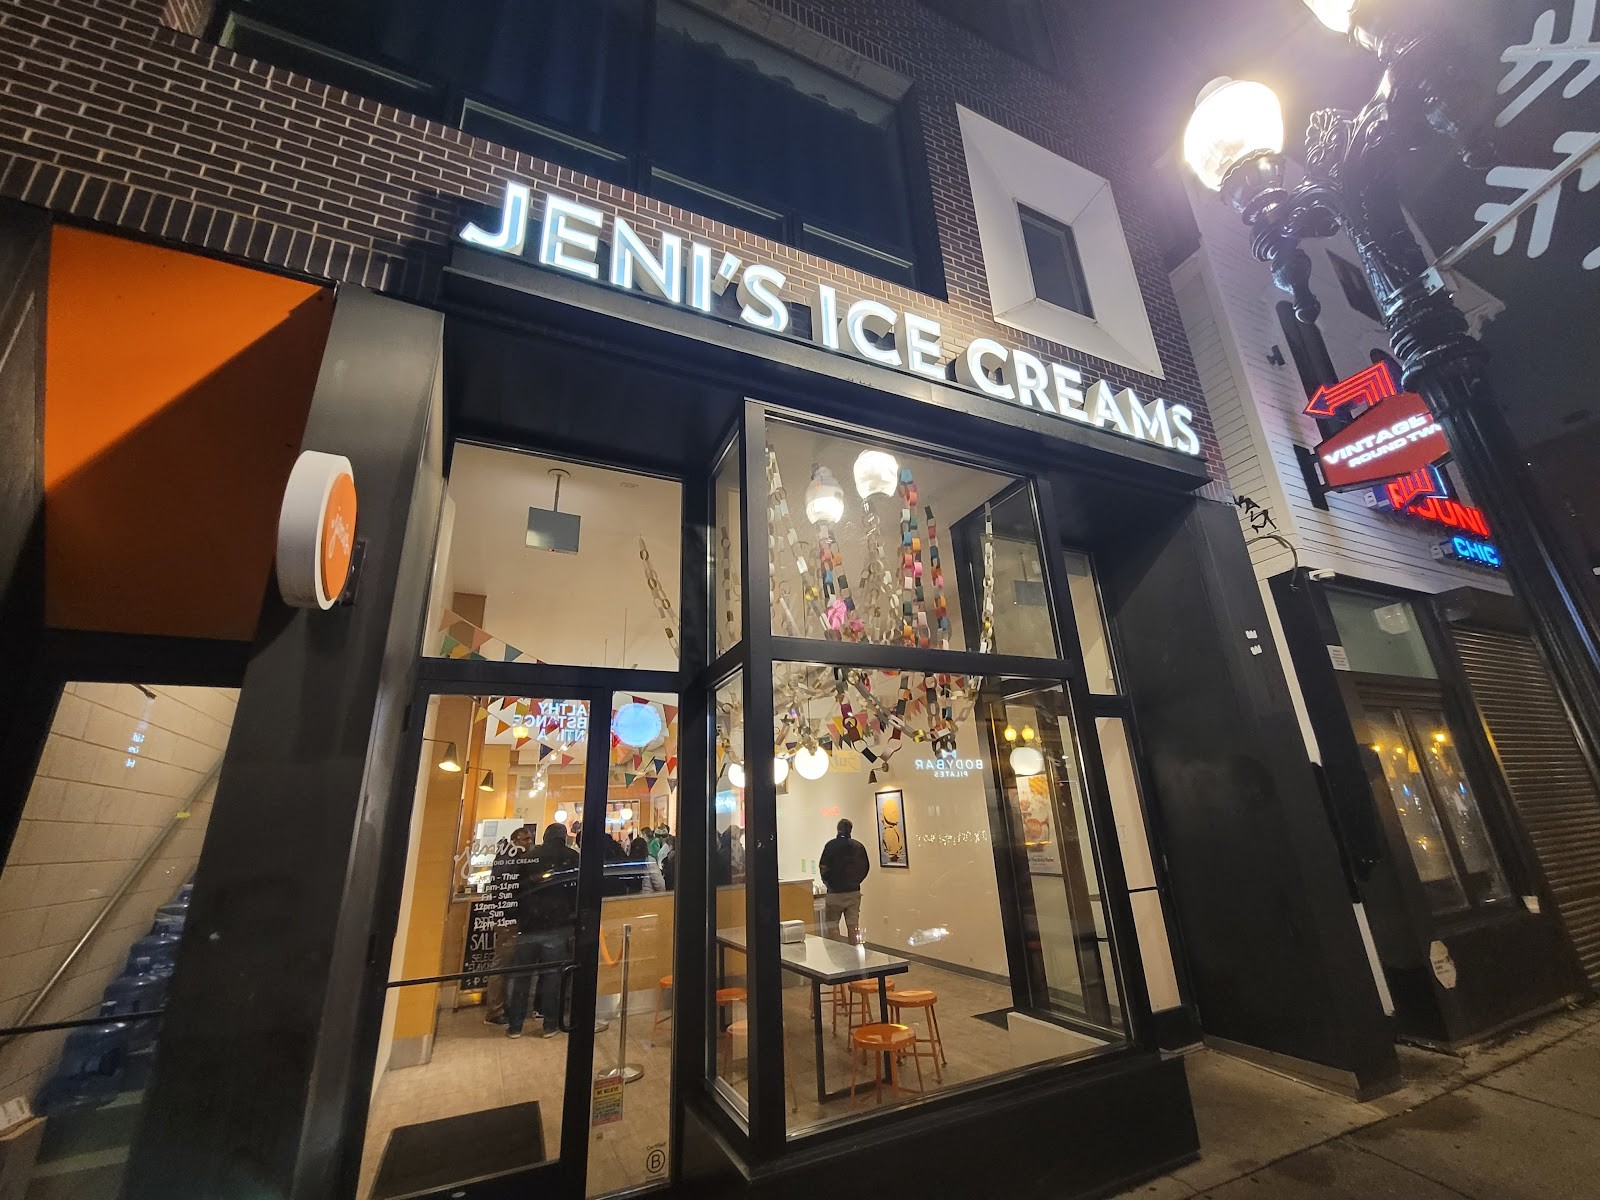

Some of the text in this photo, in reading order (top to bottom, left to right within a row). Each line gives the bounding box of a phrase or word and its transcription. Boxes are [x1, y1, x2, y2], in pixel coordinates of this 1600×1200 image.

[459, 181, 1200, 455] JENI'S ICE CREAMS
[1323, 413, 1428, 465] VINTAGE
[1348, 436, 1408, 468] ROUND
[502, 872, 520, 881] Thur
[516, 857, 540, 865] CREAMS
